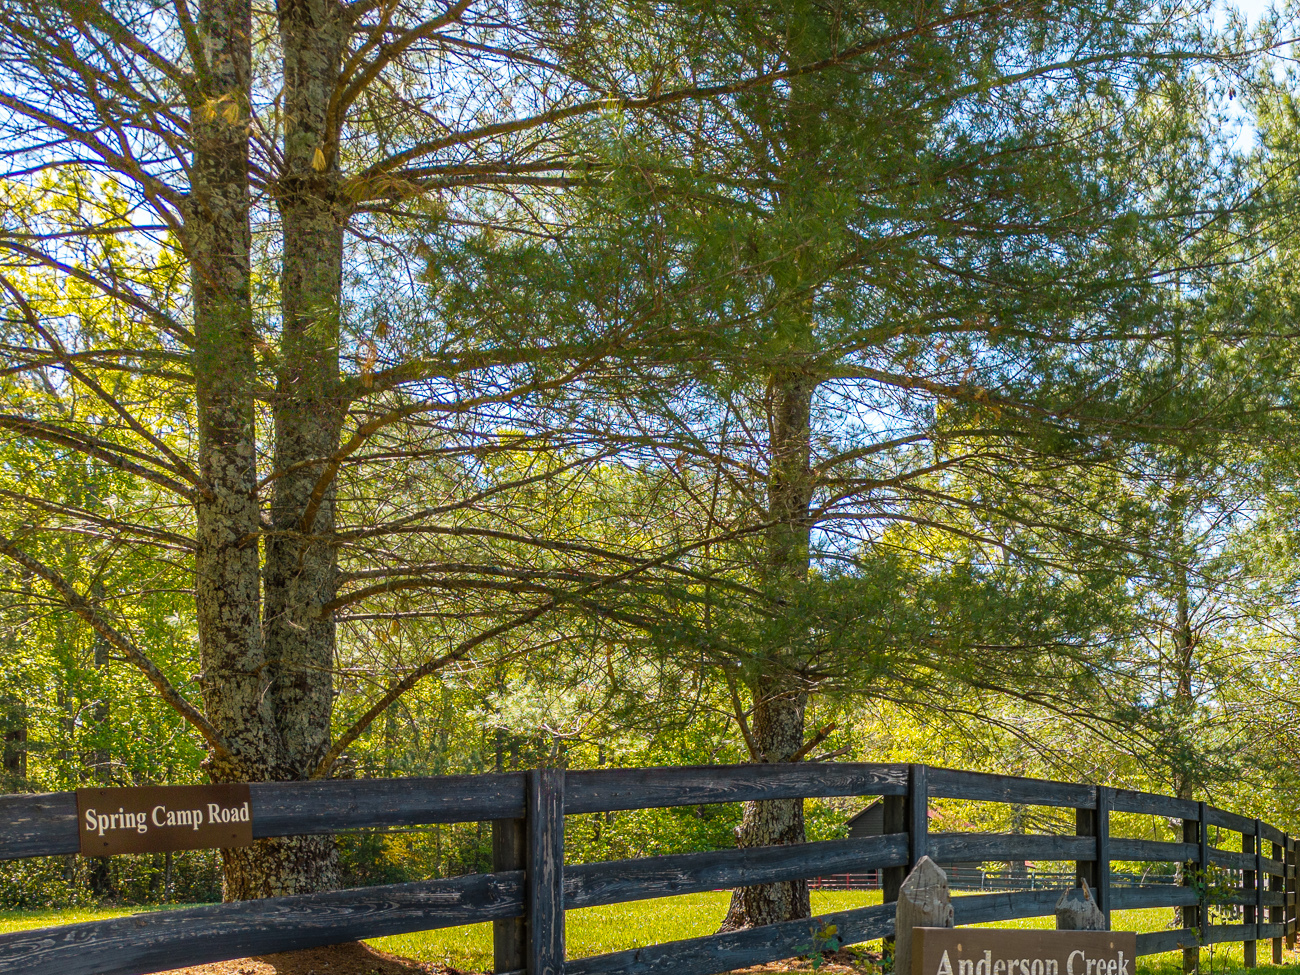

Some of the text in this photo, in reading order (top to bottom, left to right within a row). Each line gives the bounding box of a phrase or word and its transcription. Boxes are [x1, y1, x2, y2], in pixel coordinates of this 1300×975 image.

[85, 802, 250, 836] Spring Camp Road
